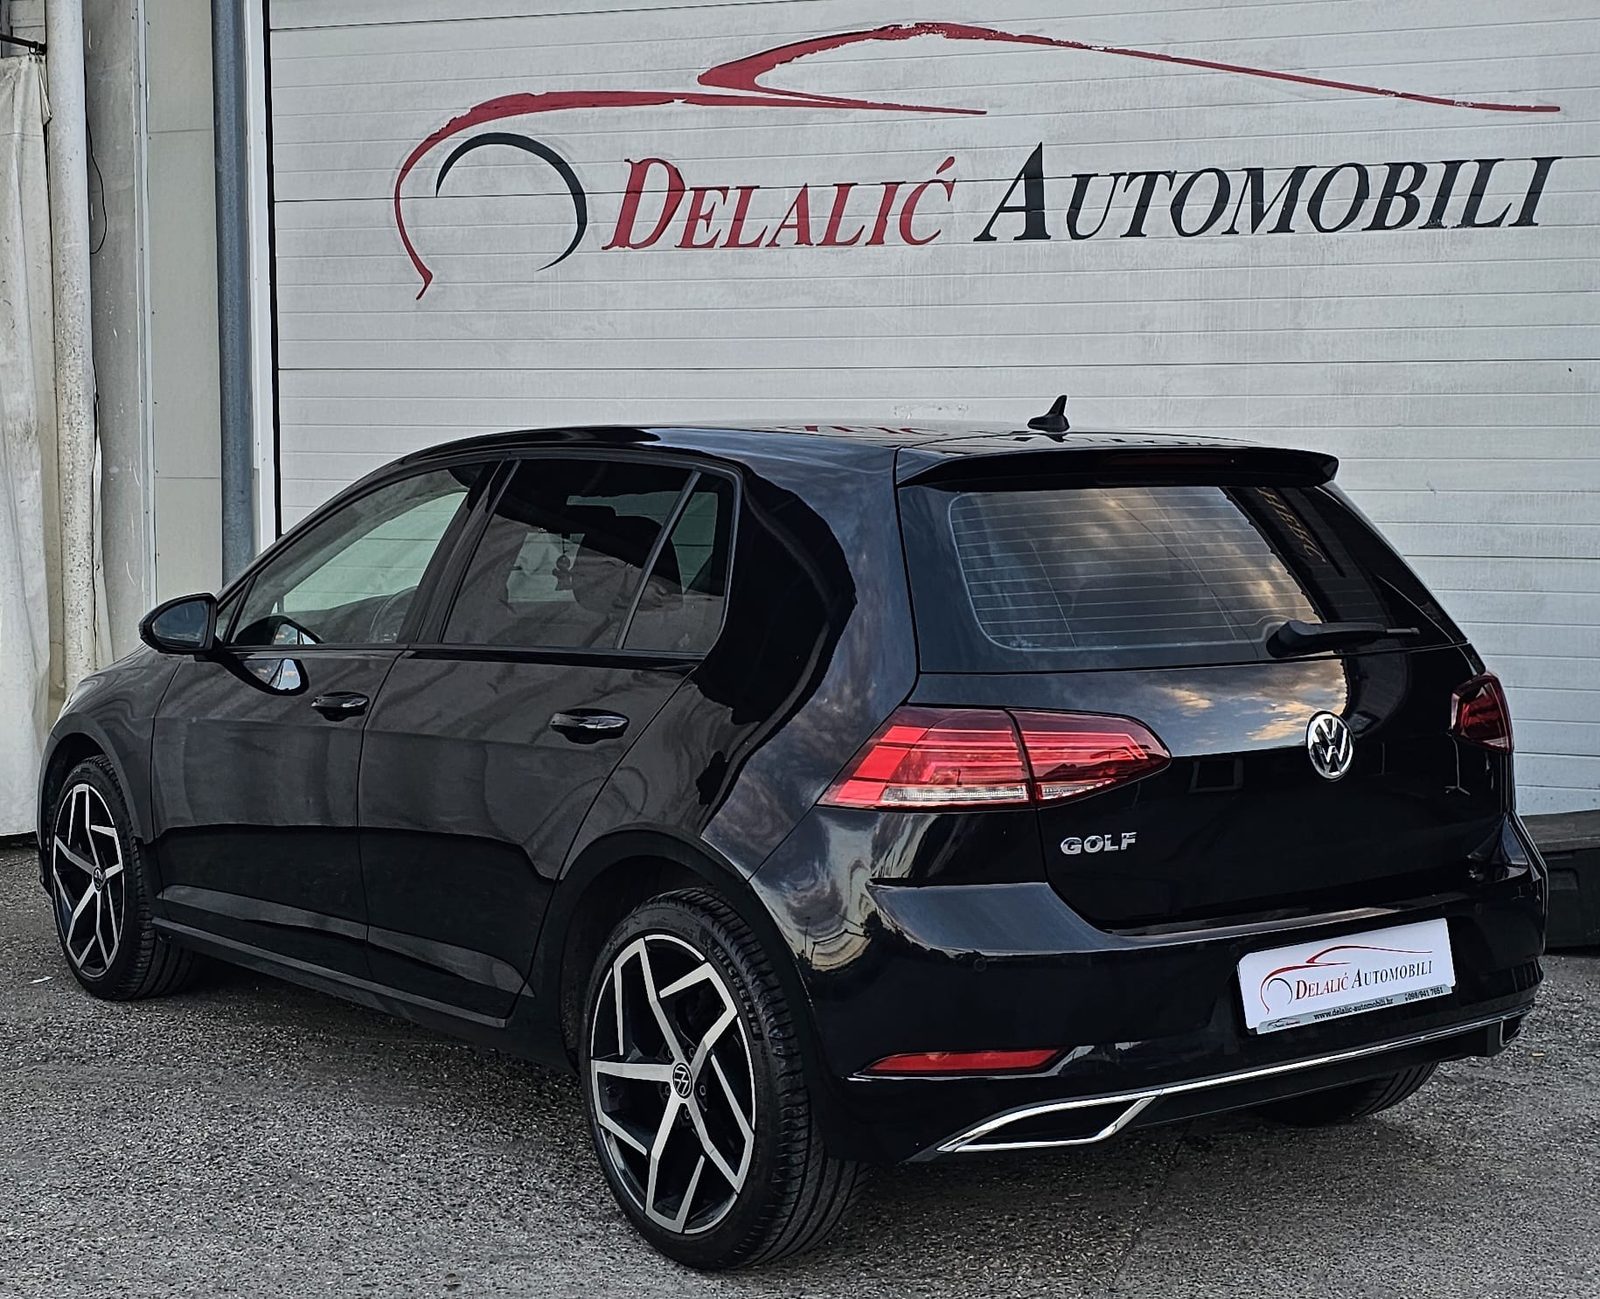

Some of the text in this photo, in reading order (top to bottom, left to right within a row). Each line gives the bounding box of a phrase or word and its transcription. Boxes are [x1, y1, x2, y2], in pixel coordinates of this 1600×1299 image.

[602, 142, 1562, 250] DELALIĆ AUTOMOBILI
[1060, 832, 1138, 855] GOLF
[713, 945, 761, 1035] MICHELIN
[1351, 960, 1432, 989] AUTOMOBILI
